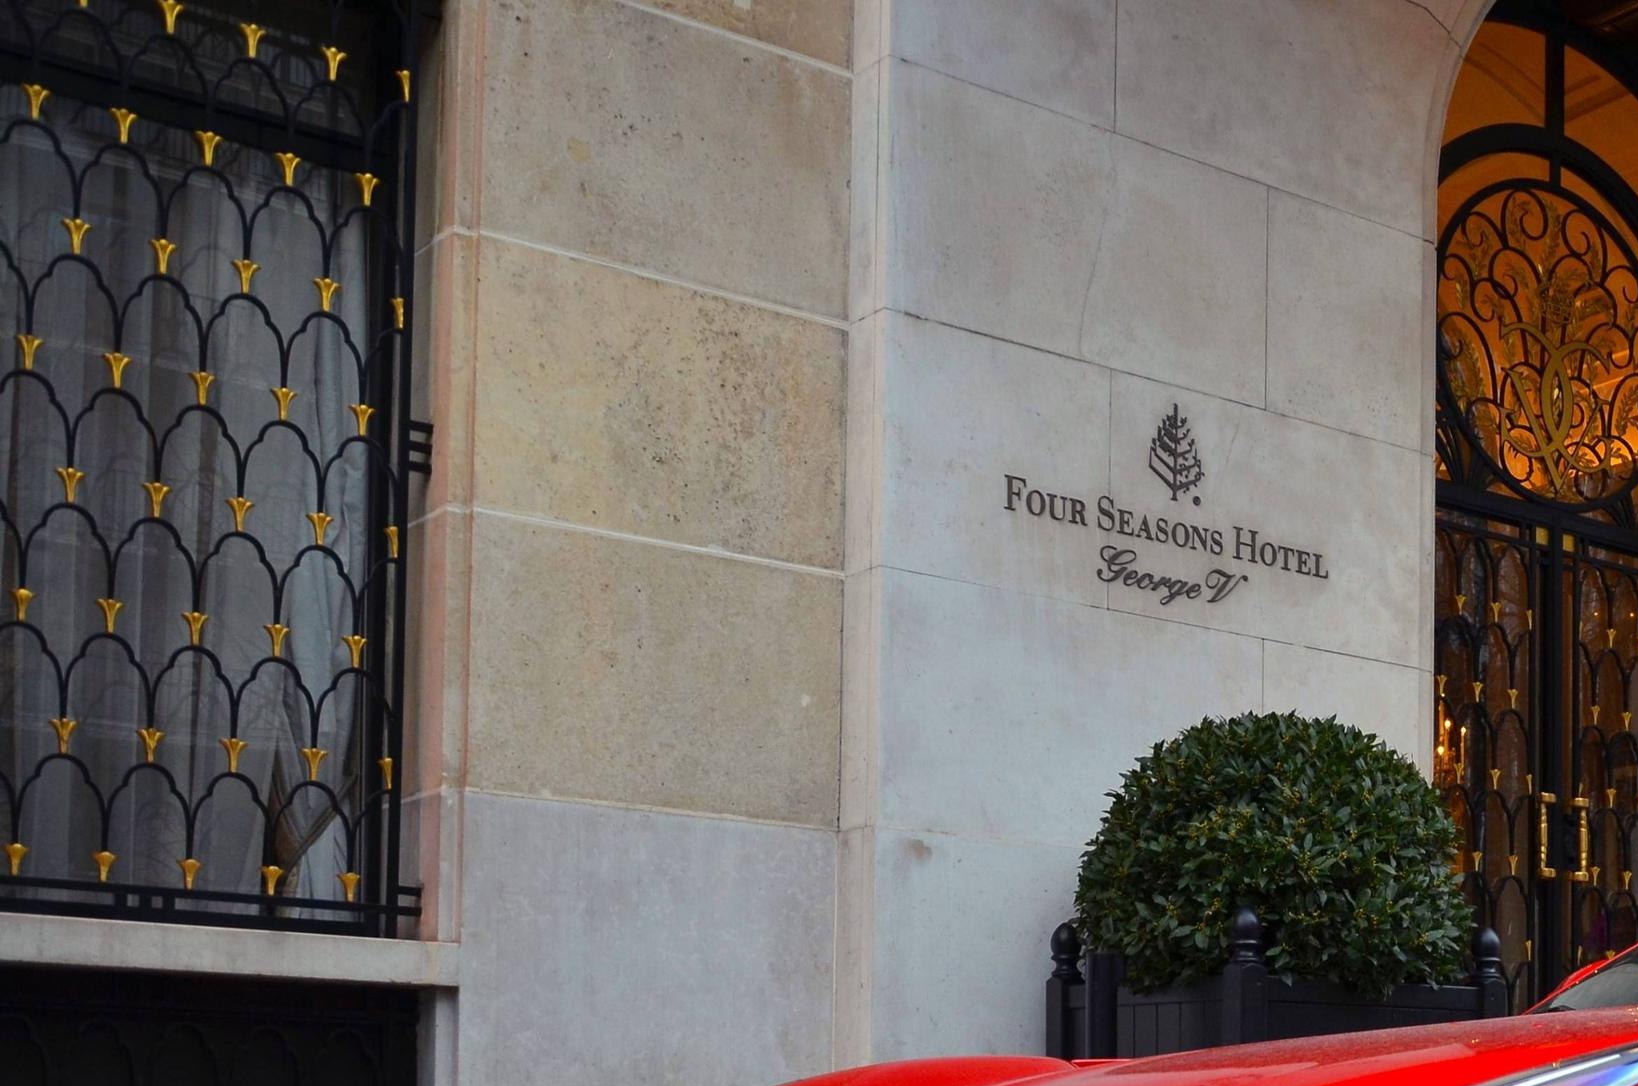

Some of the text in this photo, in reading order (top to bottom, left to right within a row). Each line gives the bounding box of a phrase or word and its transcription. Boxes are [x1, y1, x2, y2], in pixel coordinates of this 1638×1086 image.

[1003, 474, 1330, 579] FOUR SEASONS HOTEL
[1096, 545, 1249, 605] George V
